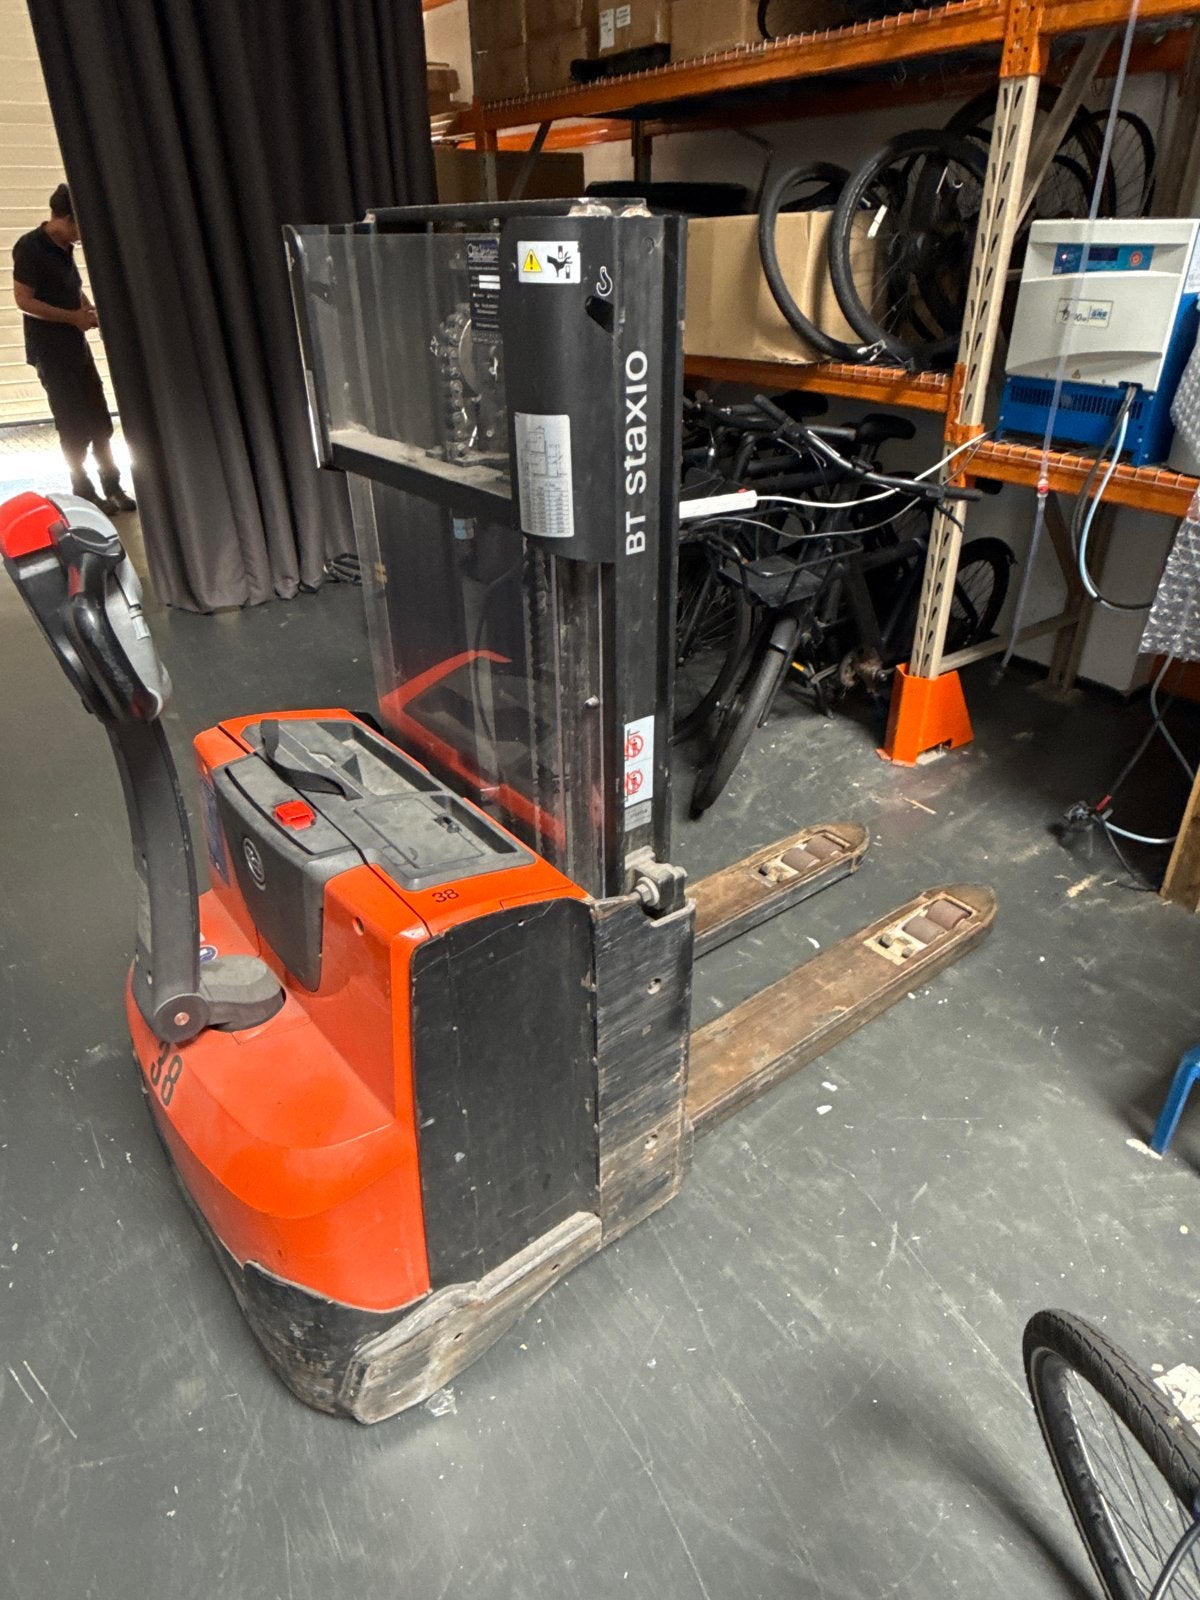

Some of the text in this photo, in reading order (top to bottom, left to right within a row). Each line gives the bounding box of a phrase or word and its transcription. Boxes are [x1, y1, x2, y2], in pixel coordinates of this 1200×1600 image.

[625, 510, 647, 556] BT
[431, 888, 460, 903] 38
[150, 1041, 183, 1106] 38
